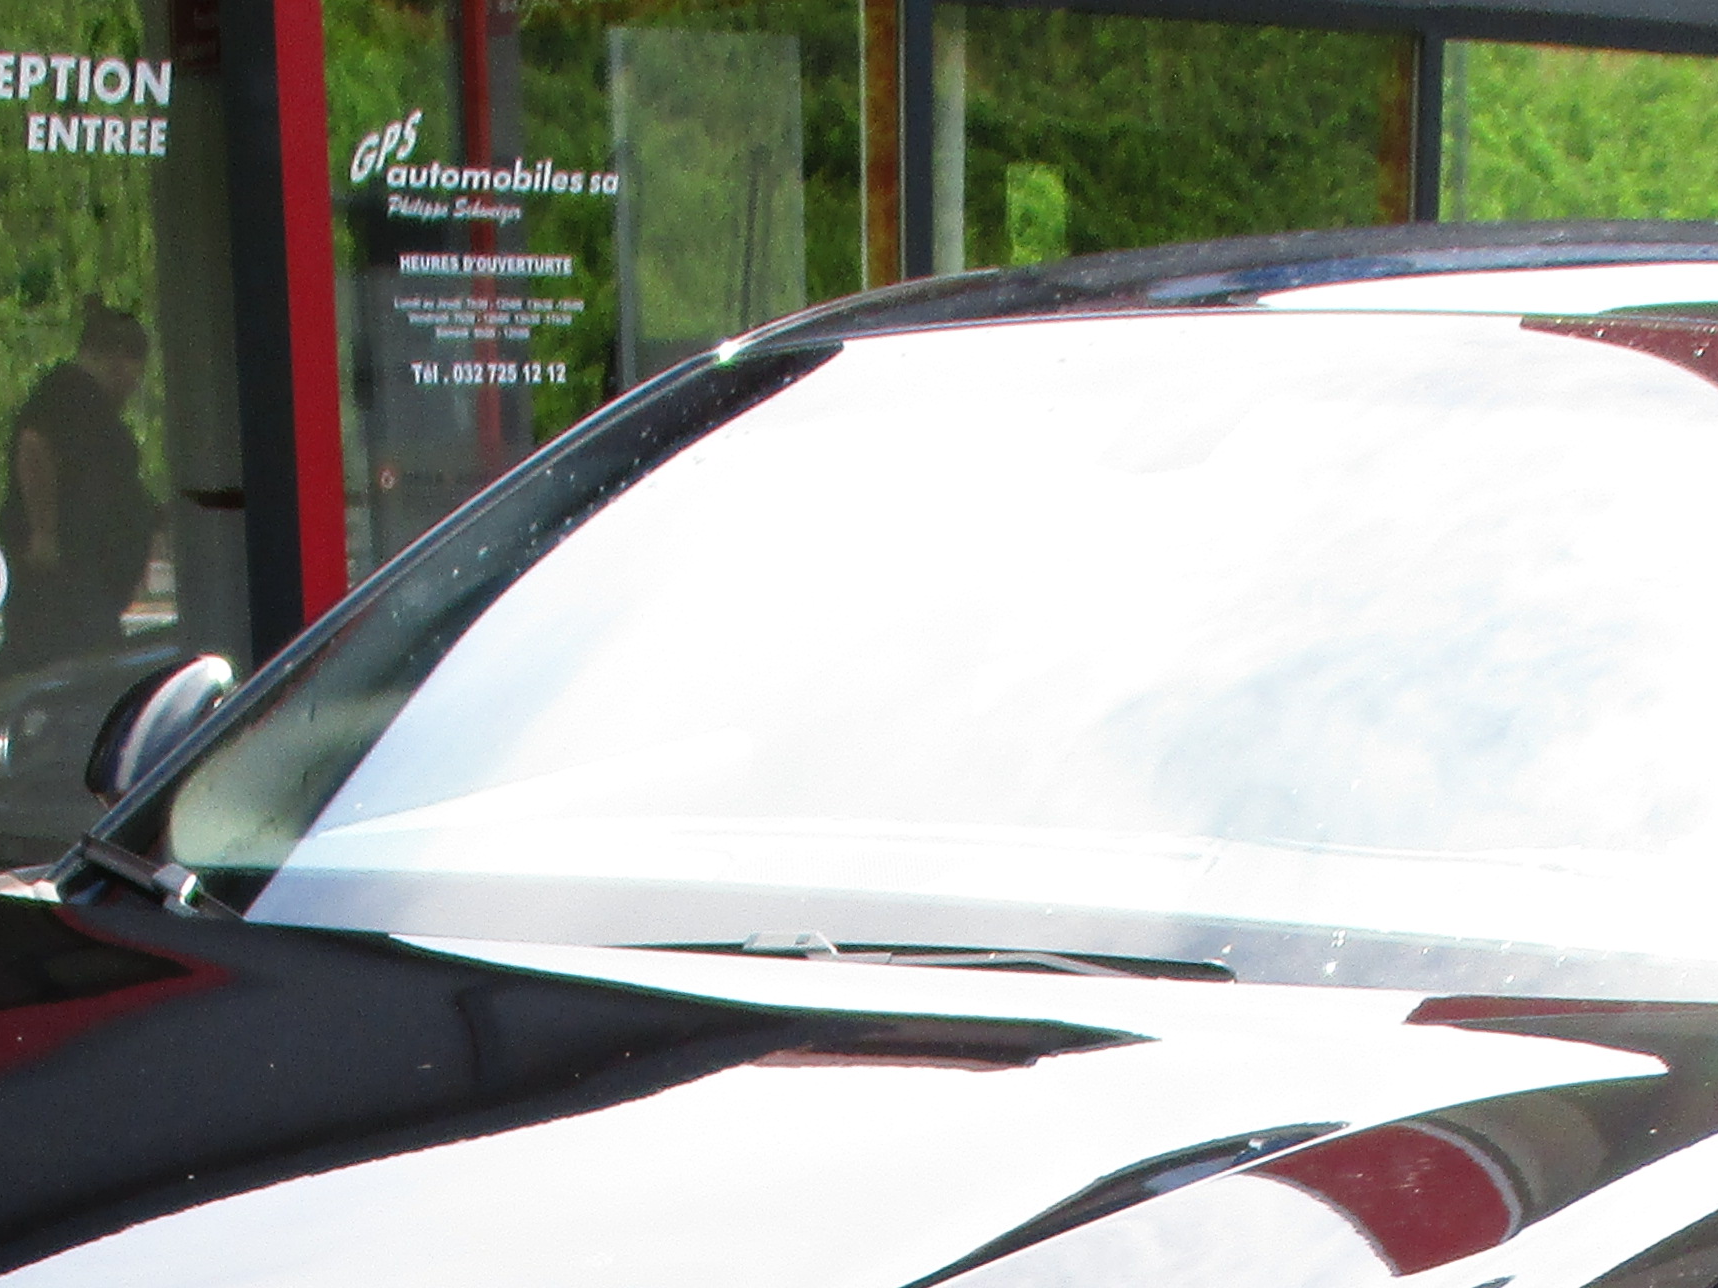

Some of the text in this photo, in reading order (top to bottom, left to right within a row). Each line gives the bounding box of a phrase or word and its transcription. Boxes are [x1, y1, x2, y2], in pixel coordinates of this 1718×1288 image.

[26, 113, 168, 156] ENTREE
[350, 107, 423, 184] GPS
[386, 156, 619, 195] automobiles sa
[398, 253, 459, 276] HEURES
[452, 361, 483, 384] 032
[488, 361, 518, 384] 725
[522, 362, 542, 384] 12
[547, 362, 567, 384] 12
